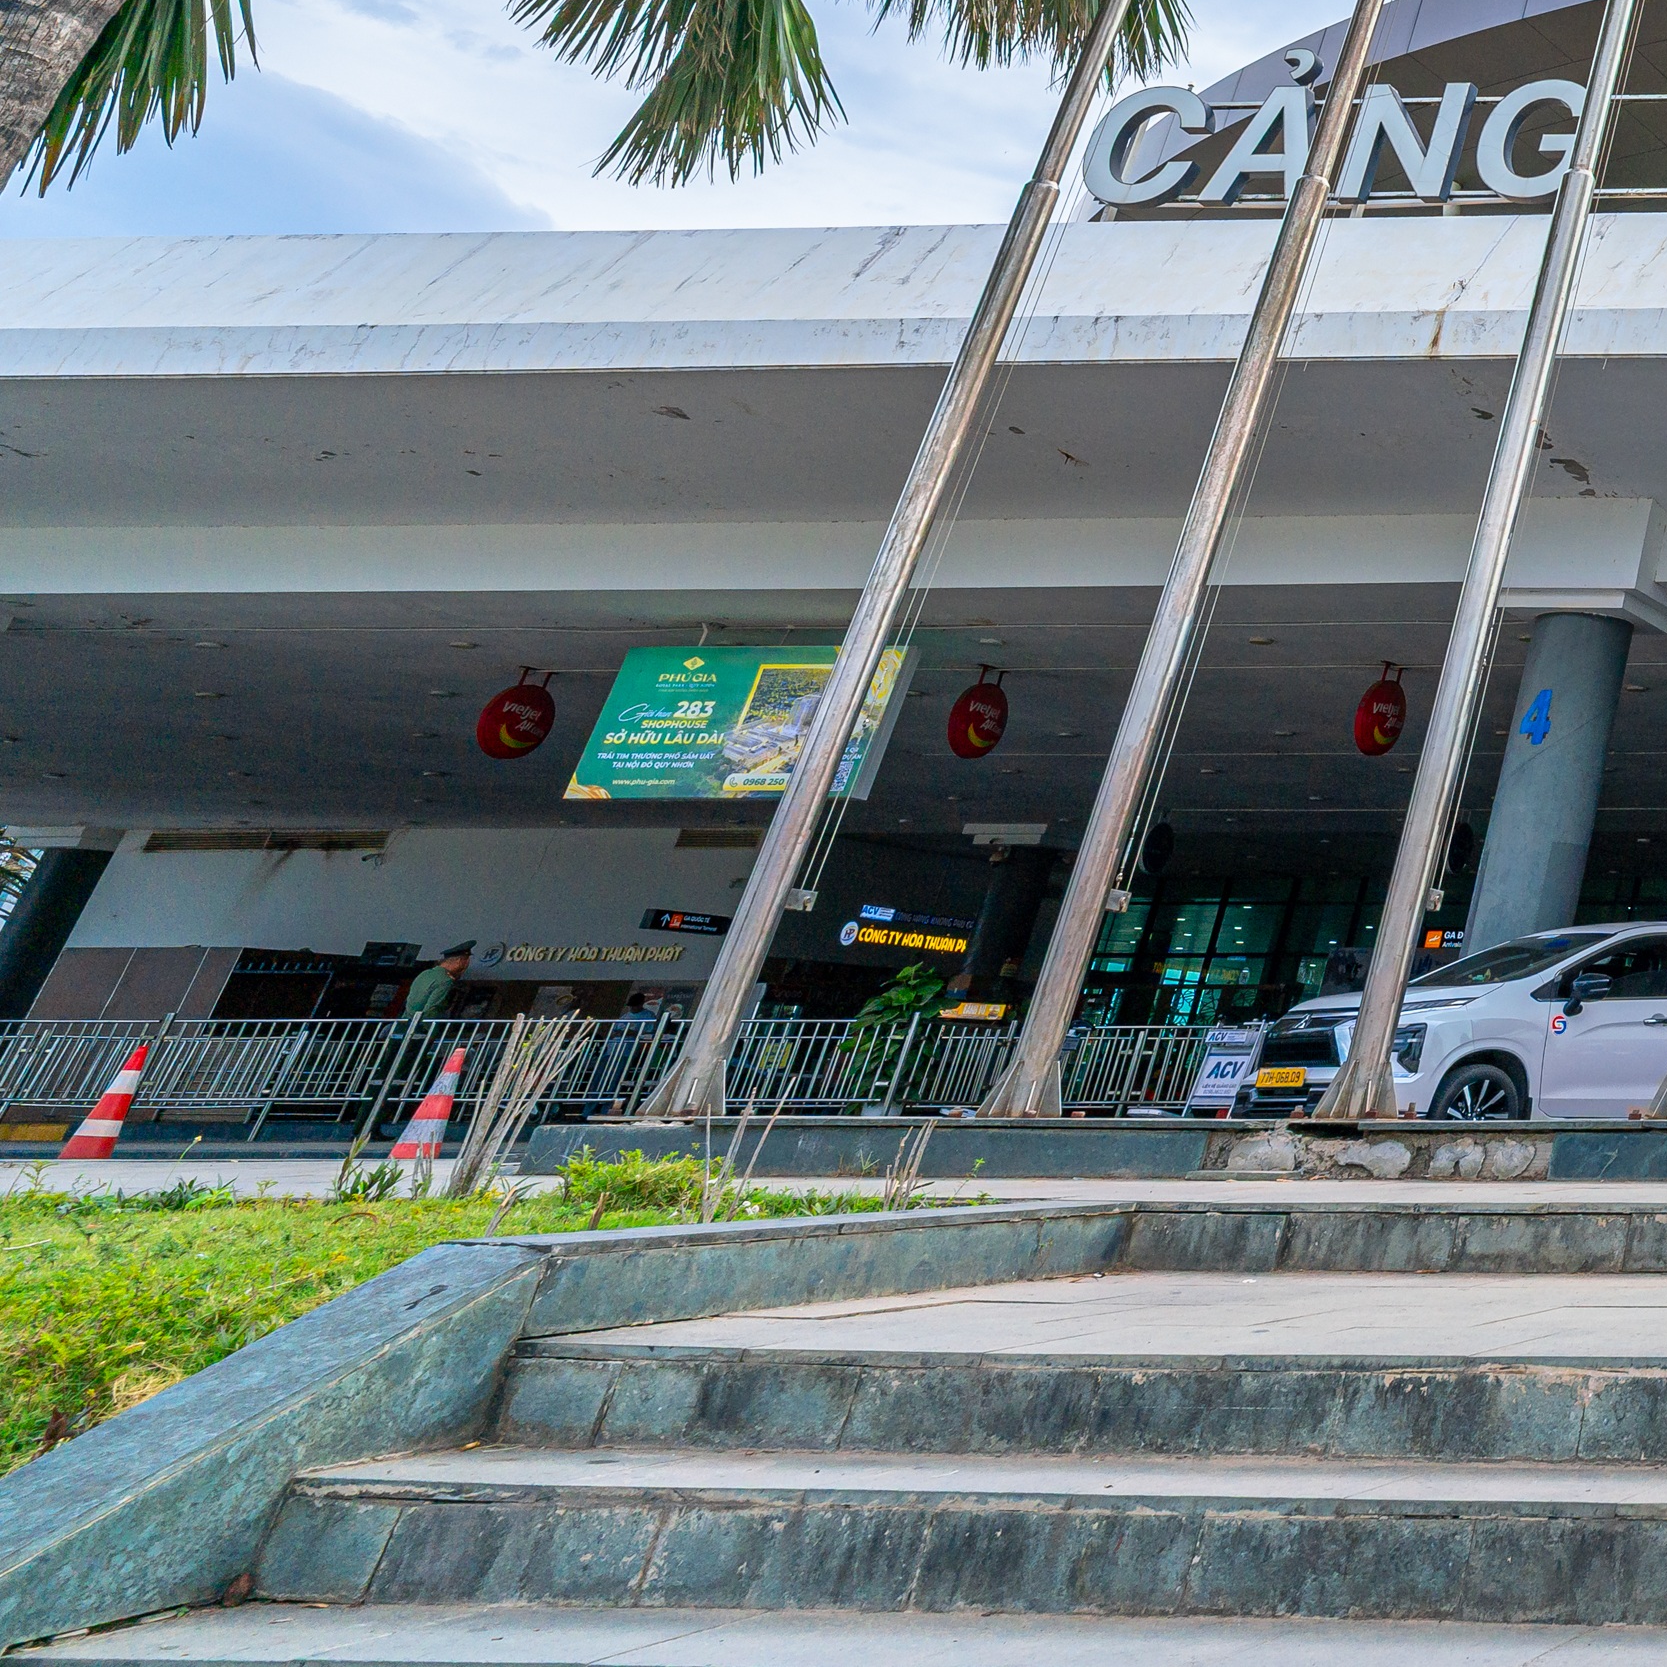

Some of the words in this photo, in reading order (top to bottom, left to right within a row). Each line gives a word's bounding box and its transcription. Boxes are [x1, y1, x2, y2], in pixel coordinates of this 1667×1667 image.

[1083, 47, 1588, 208] CẢNG
[673, 700, 716, 718] 283
[641, 720, 709, 729] SHOPHOUSE
[1521, 689, 1552, 745] 4
[603, 729, 628, 744] SỞ
[628, 730, 662, 744] HỮU
[663, 730, 695, 744] LÂU
[696, 730, 724, 744] DÀI
[612, 778, 676, 787] www.phu-gia.com
[742, 777, 766, 786] 0968
[767, 777, 785, 786] 250
[858, 924, 888, 944] CÔNG
[887, 931, 903, 946] TY
[1443, 931, 1456, 940] GA
[1208, 1032, 1228, 1041] ACV
[1206, 1061, 1245, 1079] ACV
